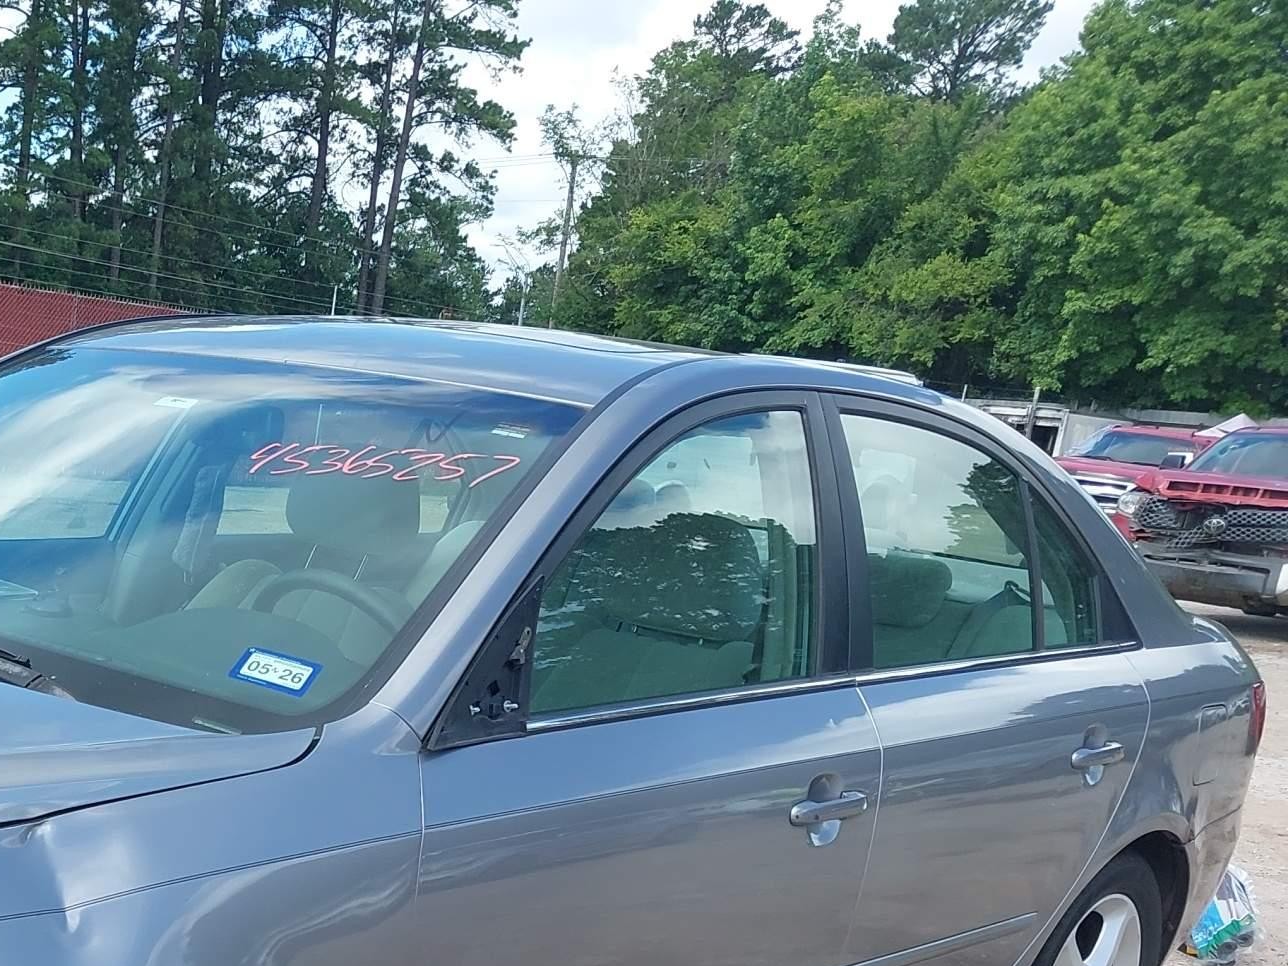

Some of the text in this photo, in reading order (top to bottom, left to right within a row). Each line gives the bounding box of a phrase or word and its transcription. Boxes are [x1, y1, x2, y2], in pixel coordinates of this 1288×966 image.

[249, 442, 520, 488] 45365257
[247, 660, 273, 675] 05
[278, 668, 305, 684] 26
